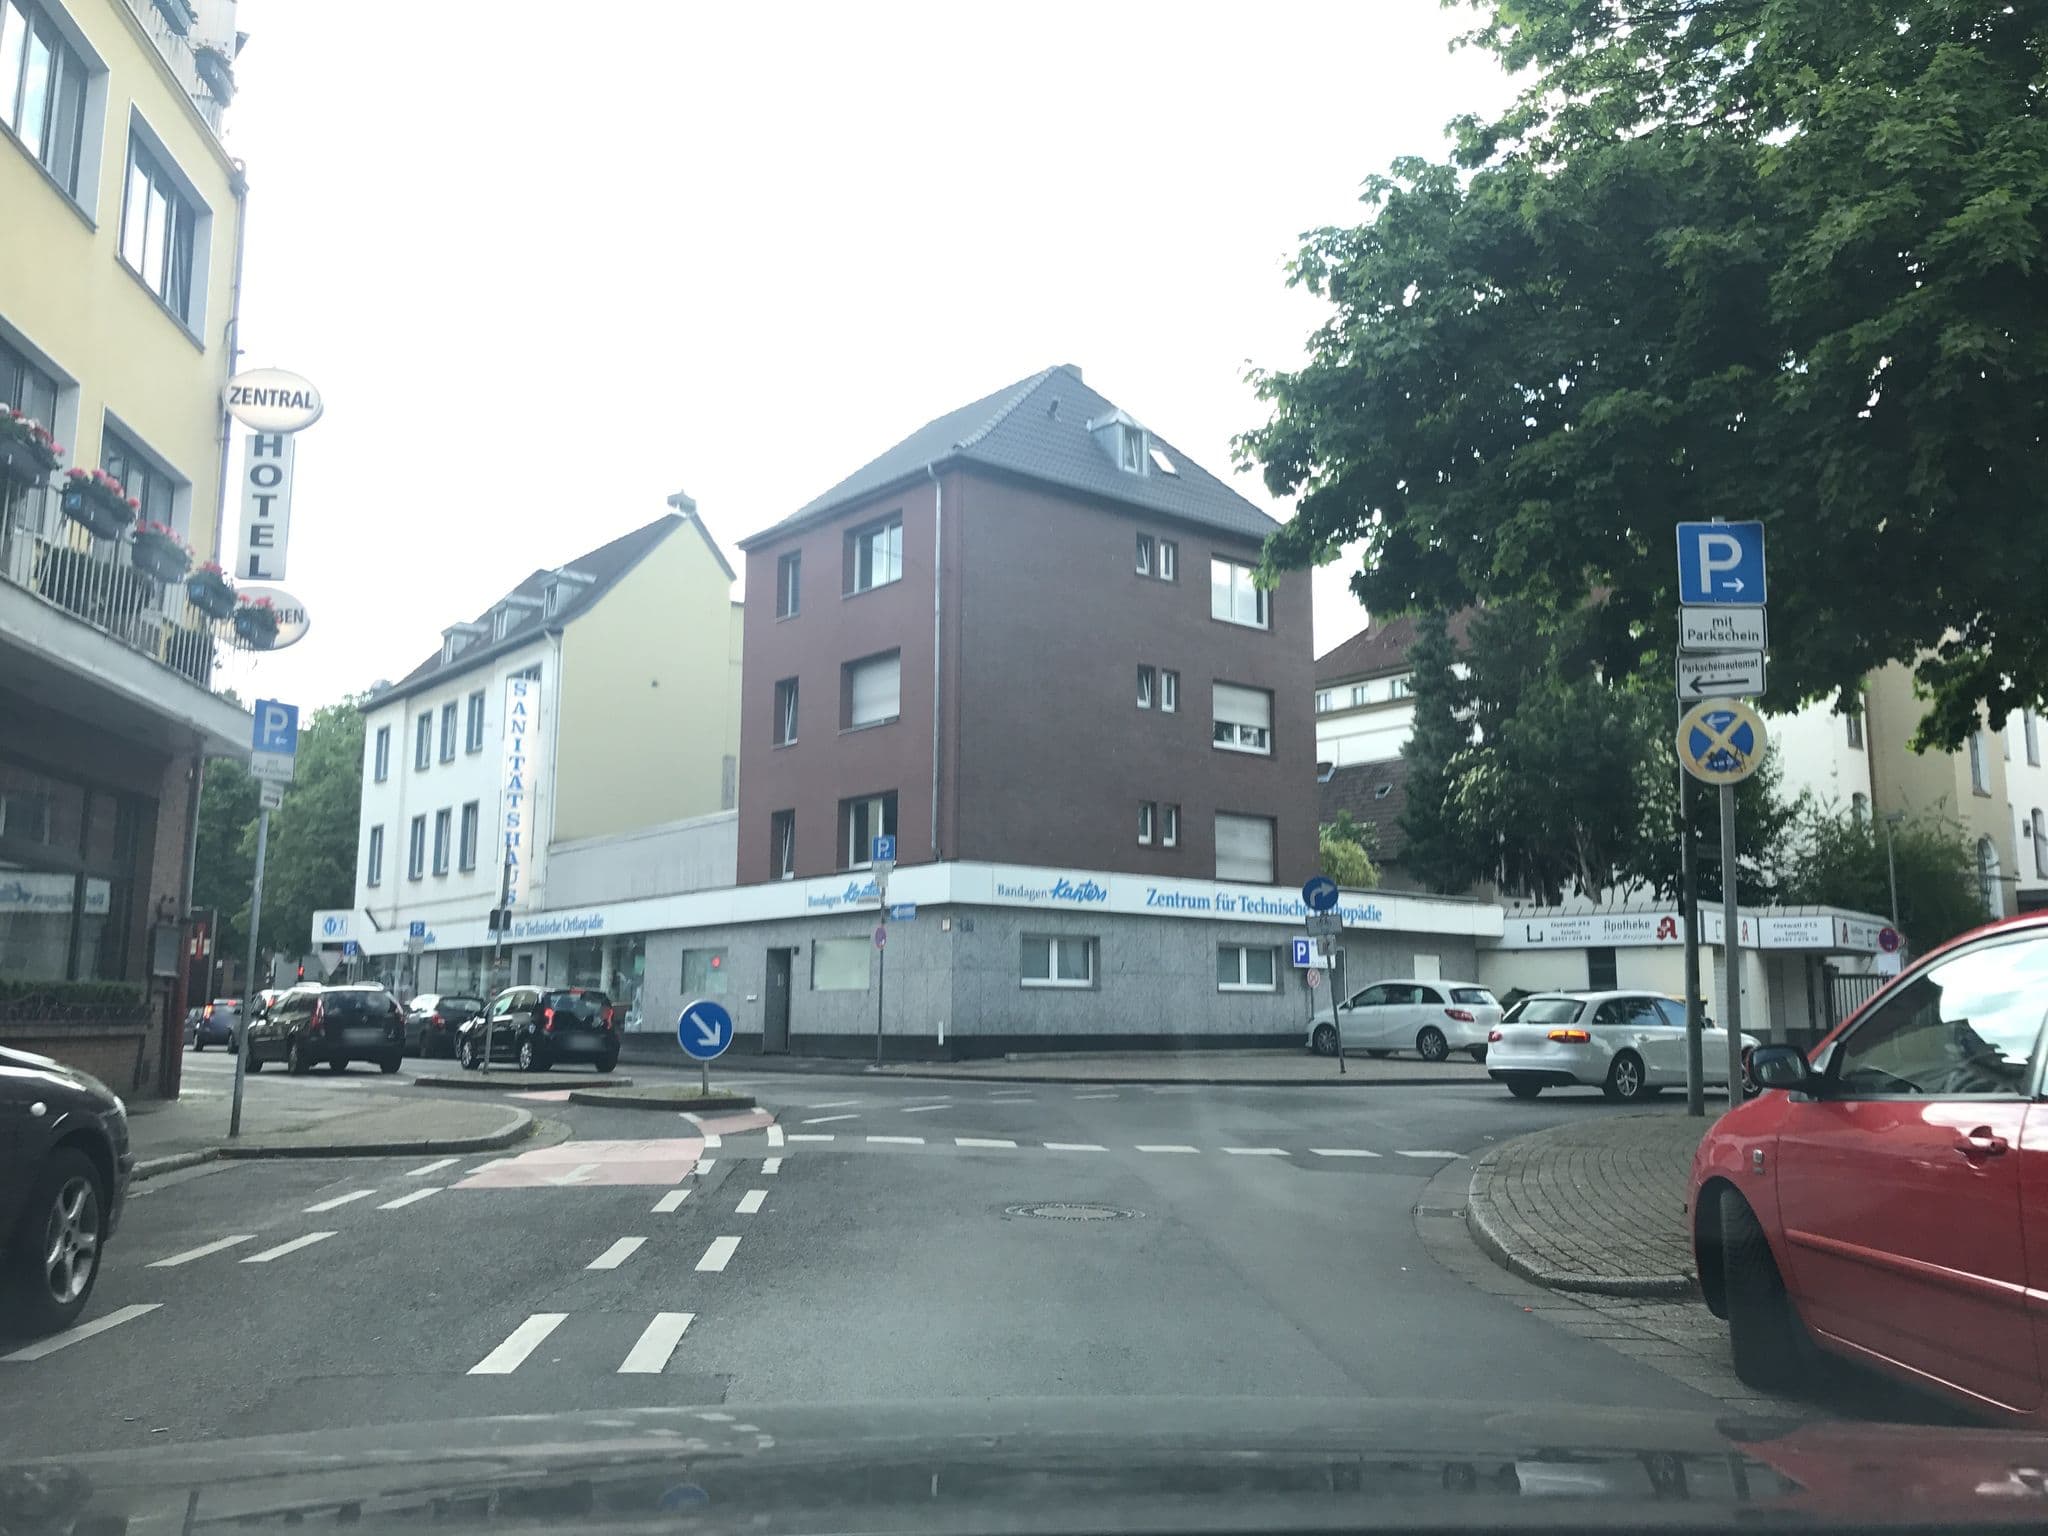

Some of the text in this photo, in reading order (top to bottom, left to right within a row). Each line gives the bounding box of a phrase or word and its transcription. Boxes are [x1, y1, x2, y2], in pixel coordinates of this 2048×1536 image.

[229, 386, 314, 410] ZENTRAL
[248, 434, 284, 578] HOTEL
[1698, 533, 1743, 594] P
[1711, 616, 1733, 628] mit
[1687, 629, 1760, 642] Parkschein
[1681, 659, 1759, 674] Parkscheinautomat
[263, 706, 289, 744] P
[504, 681, 527, 904] SANITÄTSHAUS
[877, 839, 890, 858] P
[998, 877, 1108, 903] Bandagen Kanters
[1146, 888, 1211, 911] Zentrum
[1215, 889, 1237, 912] für
[1240, 894, 1309, 917] Technische
[1603, 919, 1651, 934] Apotheke
[1296, 942, 1307, 962] P
